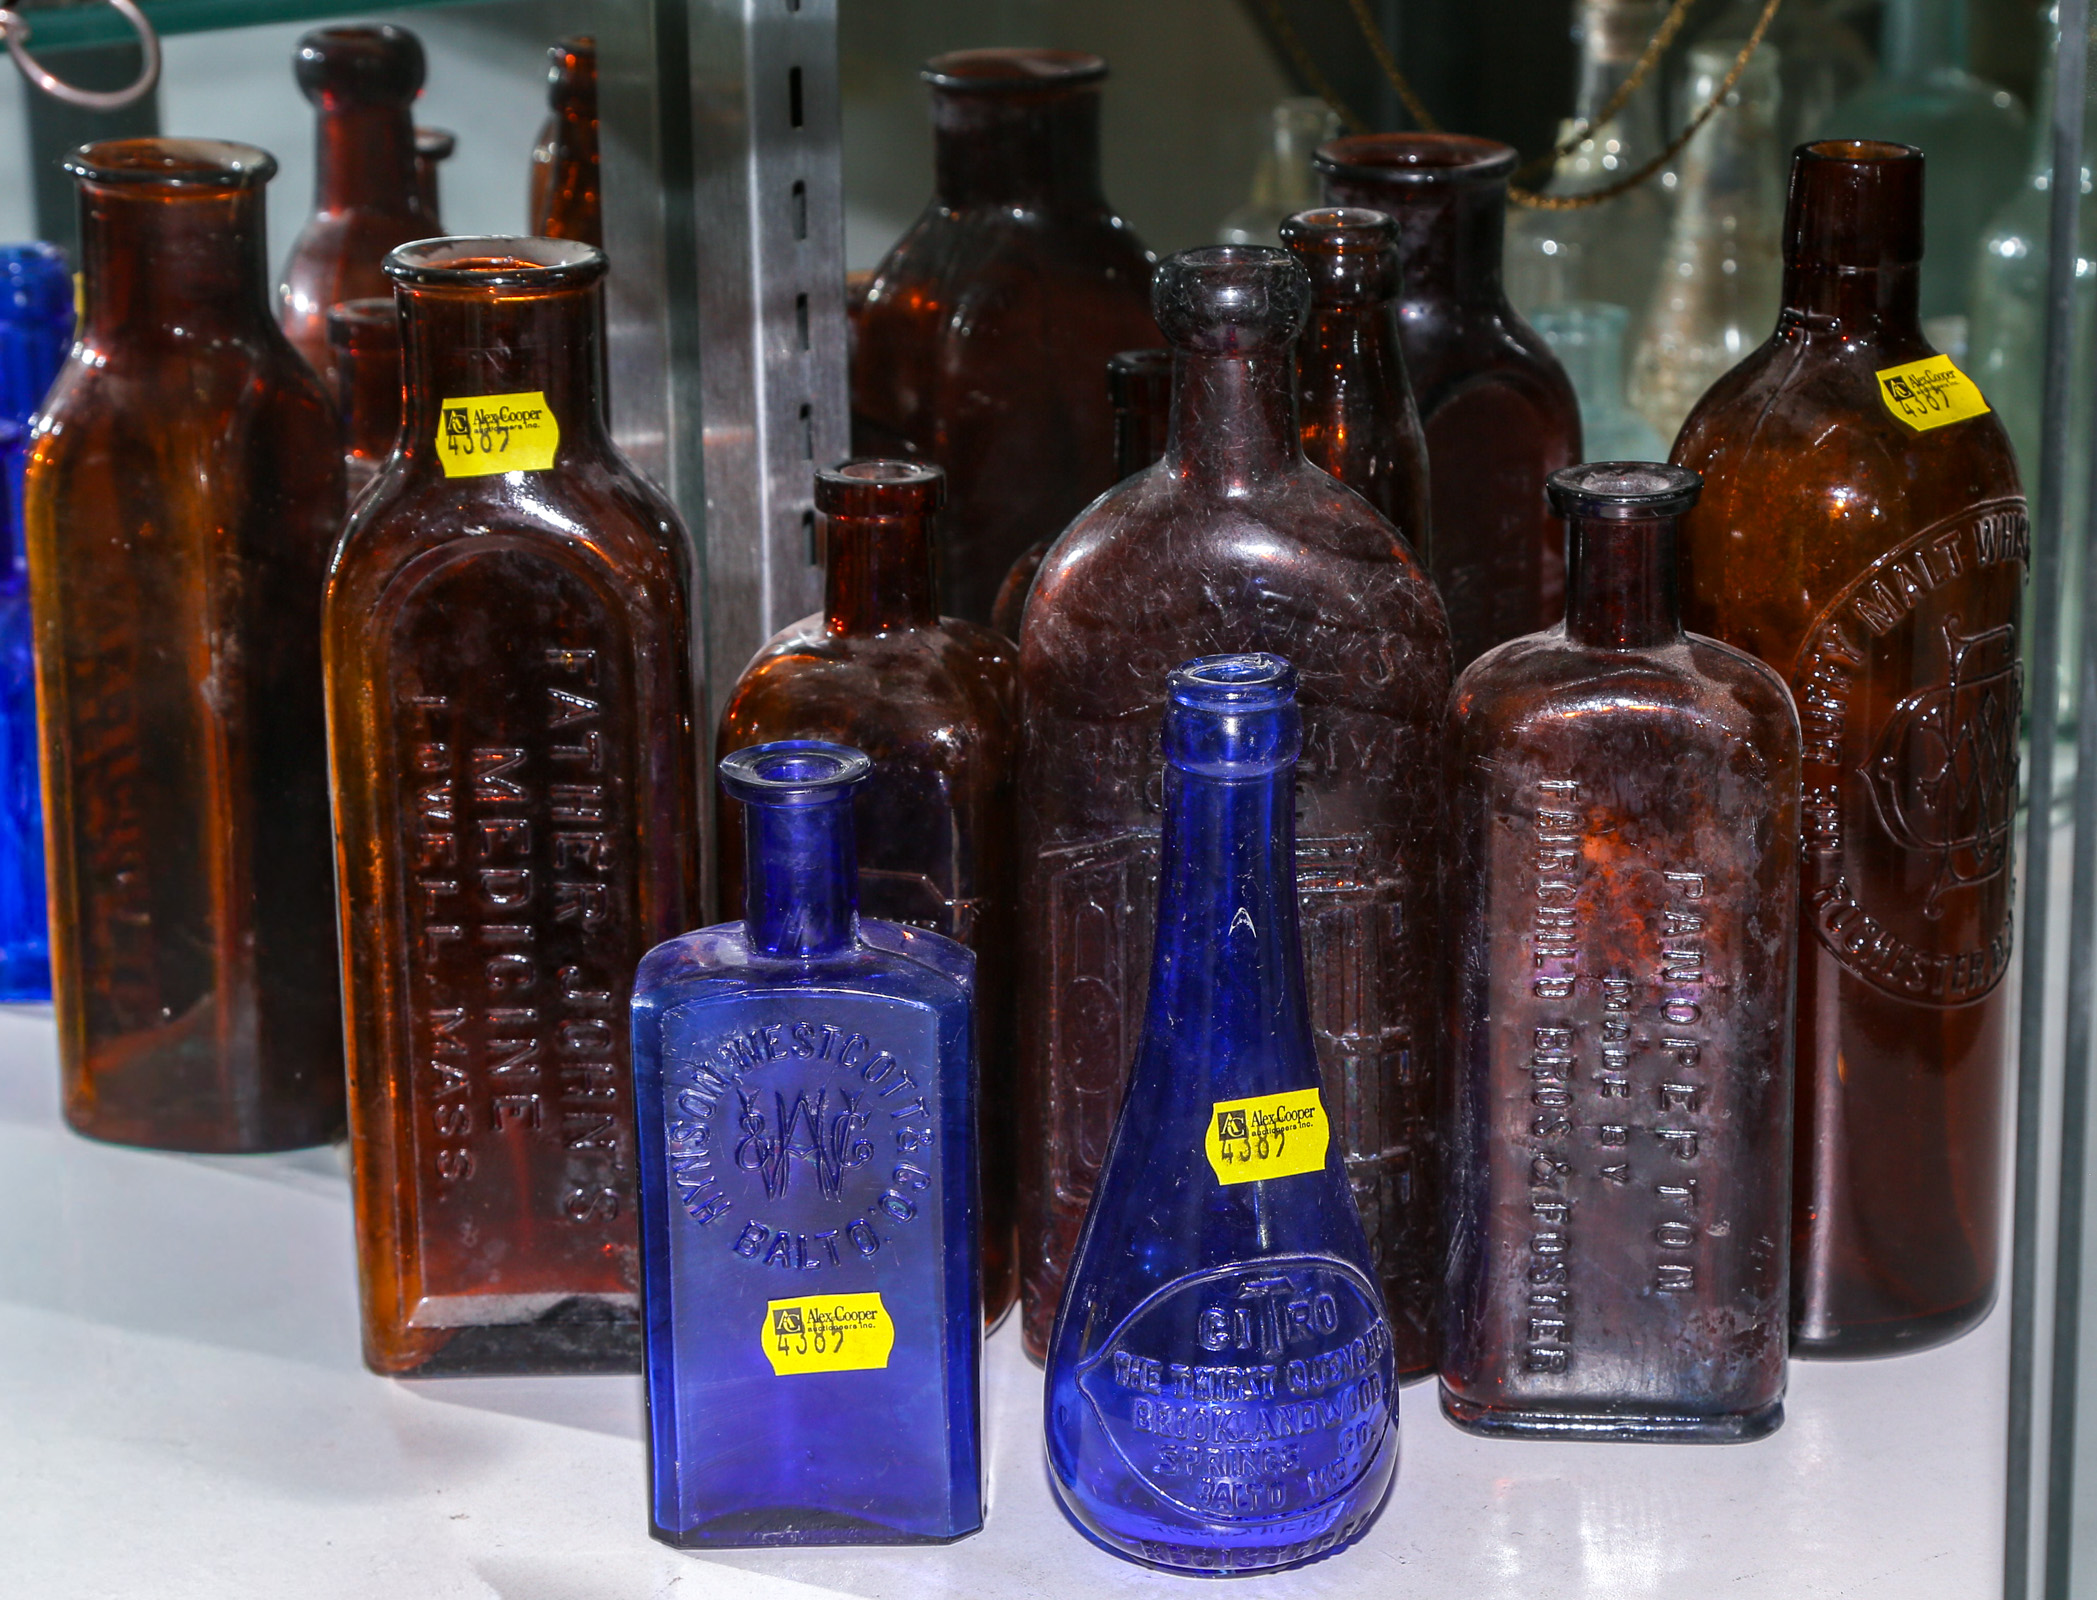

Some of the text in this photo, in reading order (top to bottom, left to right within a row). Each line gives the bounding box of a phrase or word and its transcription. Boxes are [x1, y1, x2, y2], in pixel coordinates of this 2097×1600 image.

[473, 405, 543, 426] Alex Cooper
[1908, 369, 1956, 389] Alex Cooper
[1854, 530, 1963, 637] MALT
[472, 748, 546, 1133] MEDICINE
[546, 649, 626, 1223] FATHER JOHN'S
[1535, 780, 1580, 998] FAIRCHILD
[717, 1021, 931, 1120] WESTCOTT
[896, 1126, 935, 1154] &
[1251, 1105, 1315, 1127] Alex Cooper
[1601, 979, 1631, 1185] MADE BY
[1655, 871, 1706, 1293] PANOPEPTON
[807, 1305, 878, 1324] Alex Cooper
[1199, 1276, 1338, 1358] CITRO
[1528, 1202, 1572, 1373] FOSTER
[1115, 1350, 1163, 1396] THE
[1170, 1363, 1277, 1400] THIRST
[1152, 1444, 1300, 1476] SPRINGS
